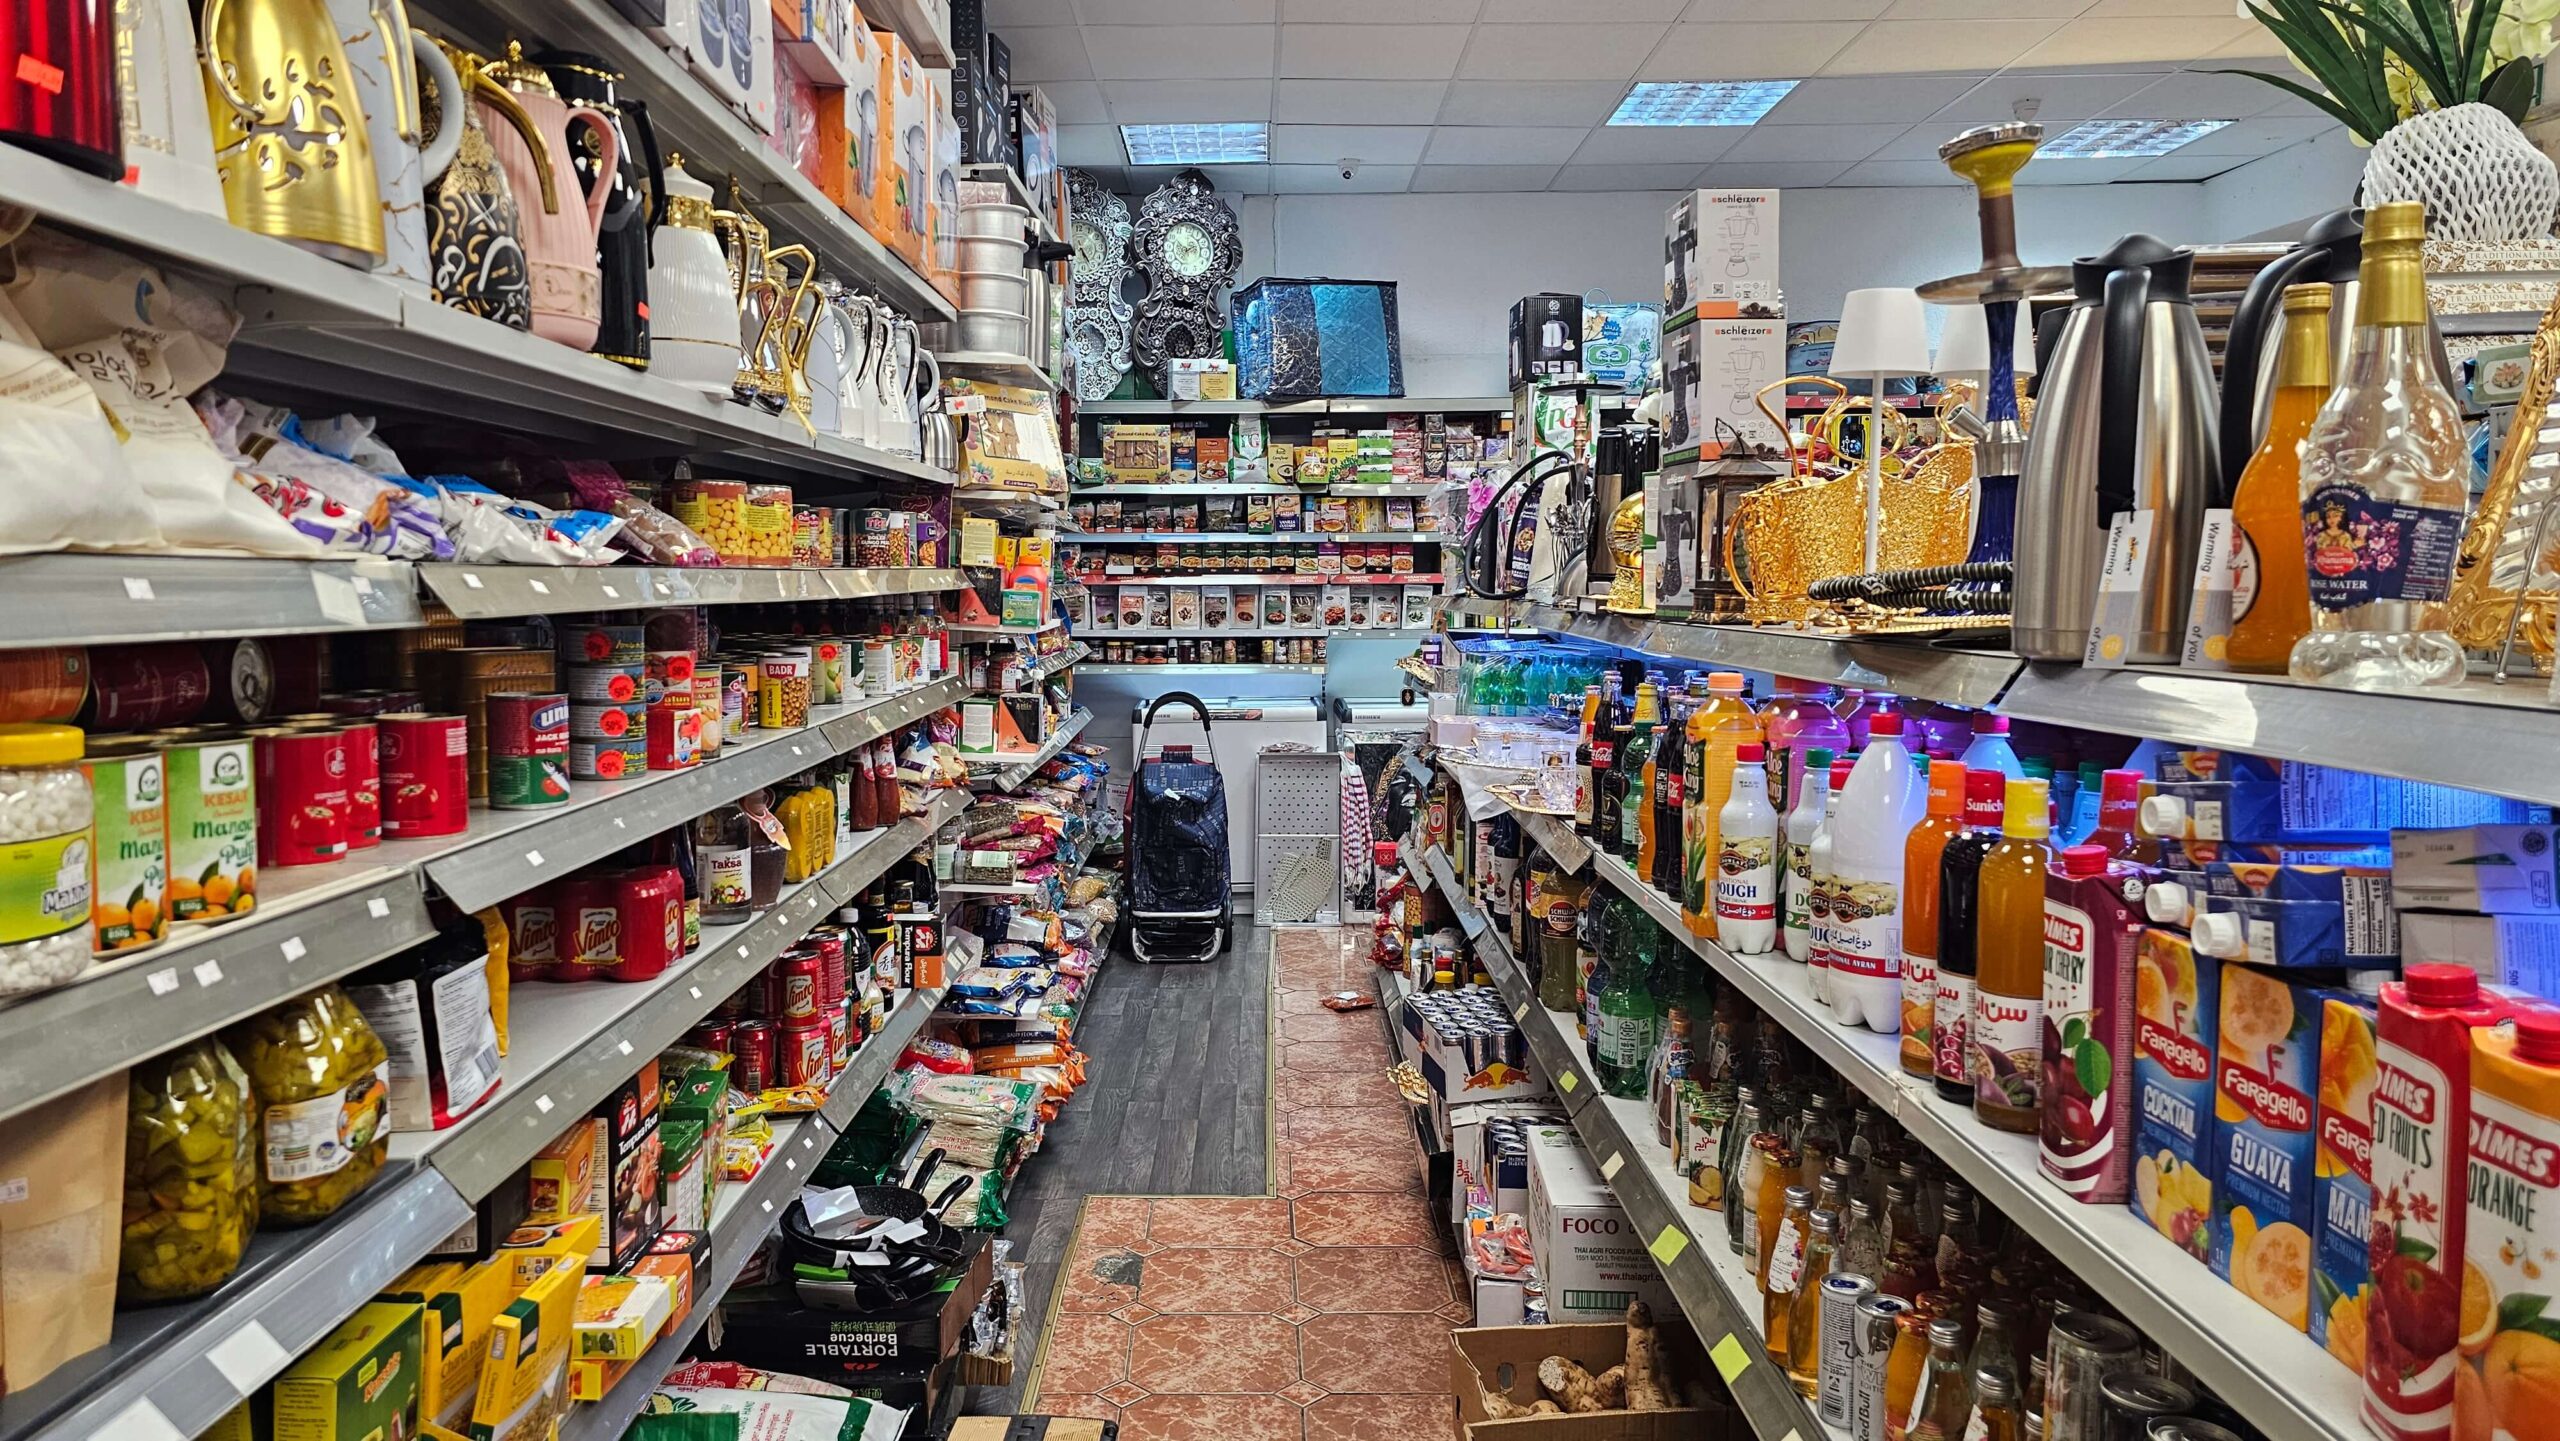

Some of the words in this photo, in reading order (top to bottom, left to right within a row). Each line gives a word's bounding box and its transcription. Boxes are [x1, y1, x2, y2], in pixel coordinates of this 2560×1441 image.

[2104, 526, 2123, 575] Warming
[2200, 522, 2221, 573] Warming
[2329, 579, 2369, 590] WATER
[2088, 639, 2100, 662] you
[2187, 639, 2201, 662] you
[769, 666, 793, 675] BADR
[1966, 798, 2004, 813] Sunich
[711, 857, 742, 870] Taksa
[2345, 877, 2354, 906] Facts
[575, 919, 621, 956] Vimto
[905, 926, 913, 962] Tempura
[2346, 907, 2355, 954] Nutrition
[2376, 919, 2384, 955] Calories
[904, 962, 913, 985] Flour
[1852, 960, 1876, 969] AYRAN
[787, 982, 814, 1008] Vimto
[2144, 1085, 2196, 1138] COCKTAIL
[617, 1128, 645, 1157] Tempura
[2390, 1109, 2432, 1169] FRUITS
[2230, 1132, 2291, 1193] GUAVA
[2225, 1171, 2261, 1203] PREMIUM
[2262, 1191, 2291, 1220] NECTAR
[2469, 1162, 2536, 1233] ORANGE
[1563, 1218, 1619, 1235] FOCO
[805, 1344, 898, 1357] PORTABLE
[830, 1333, 897, 1345] Barbecue
